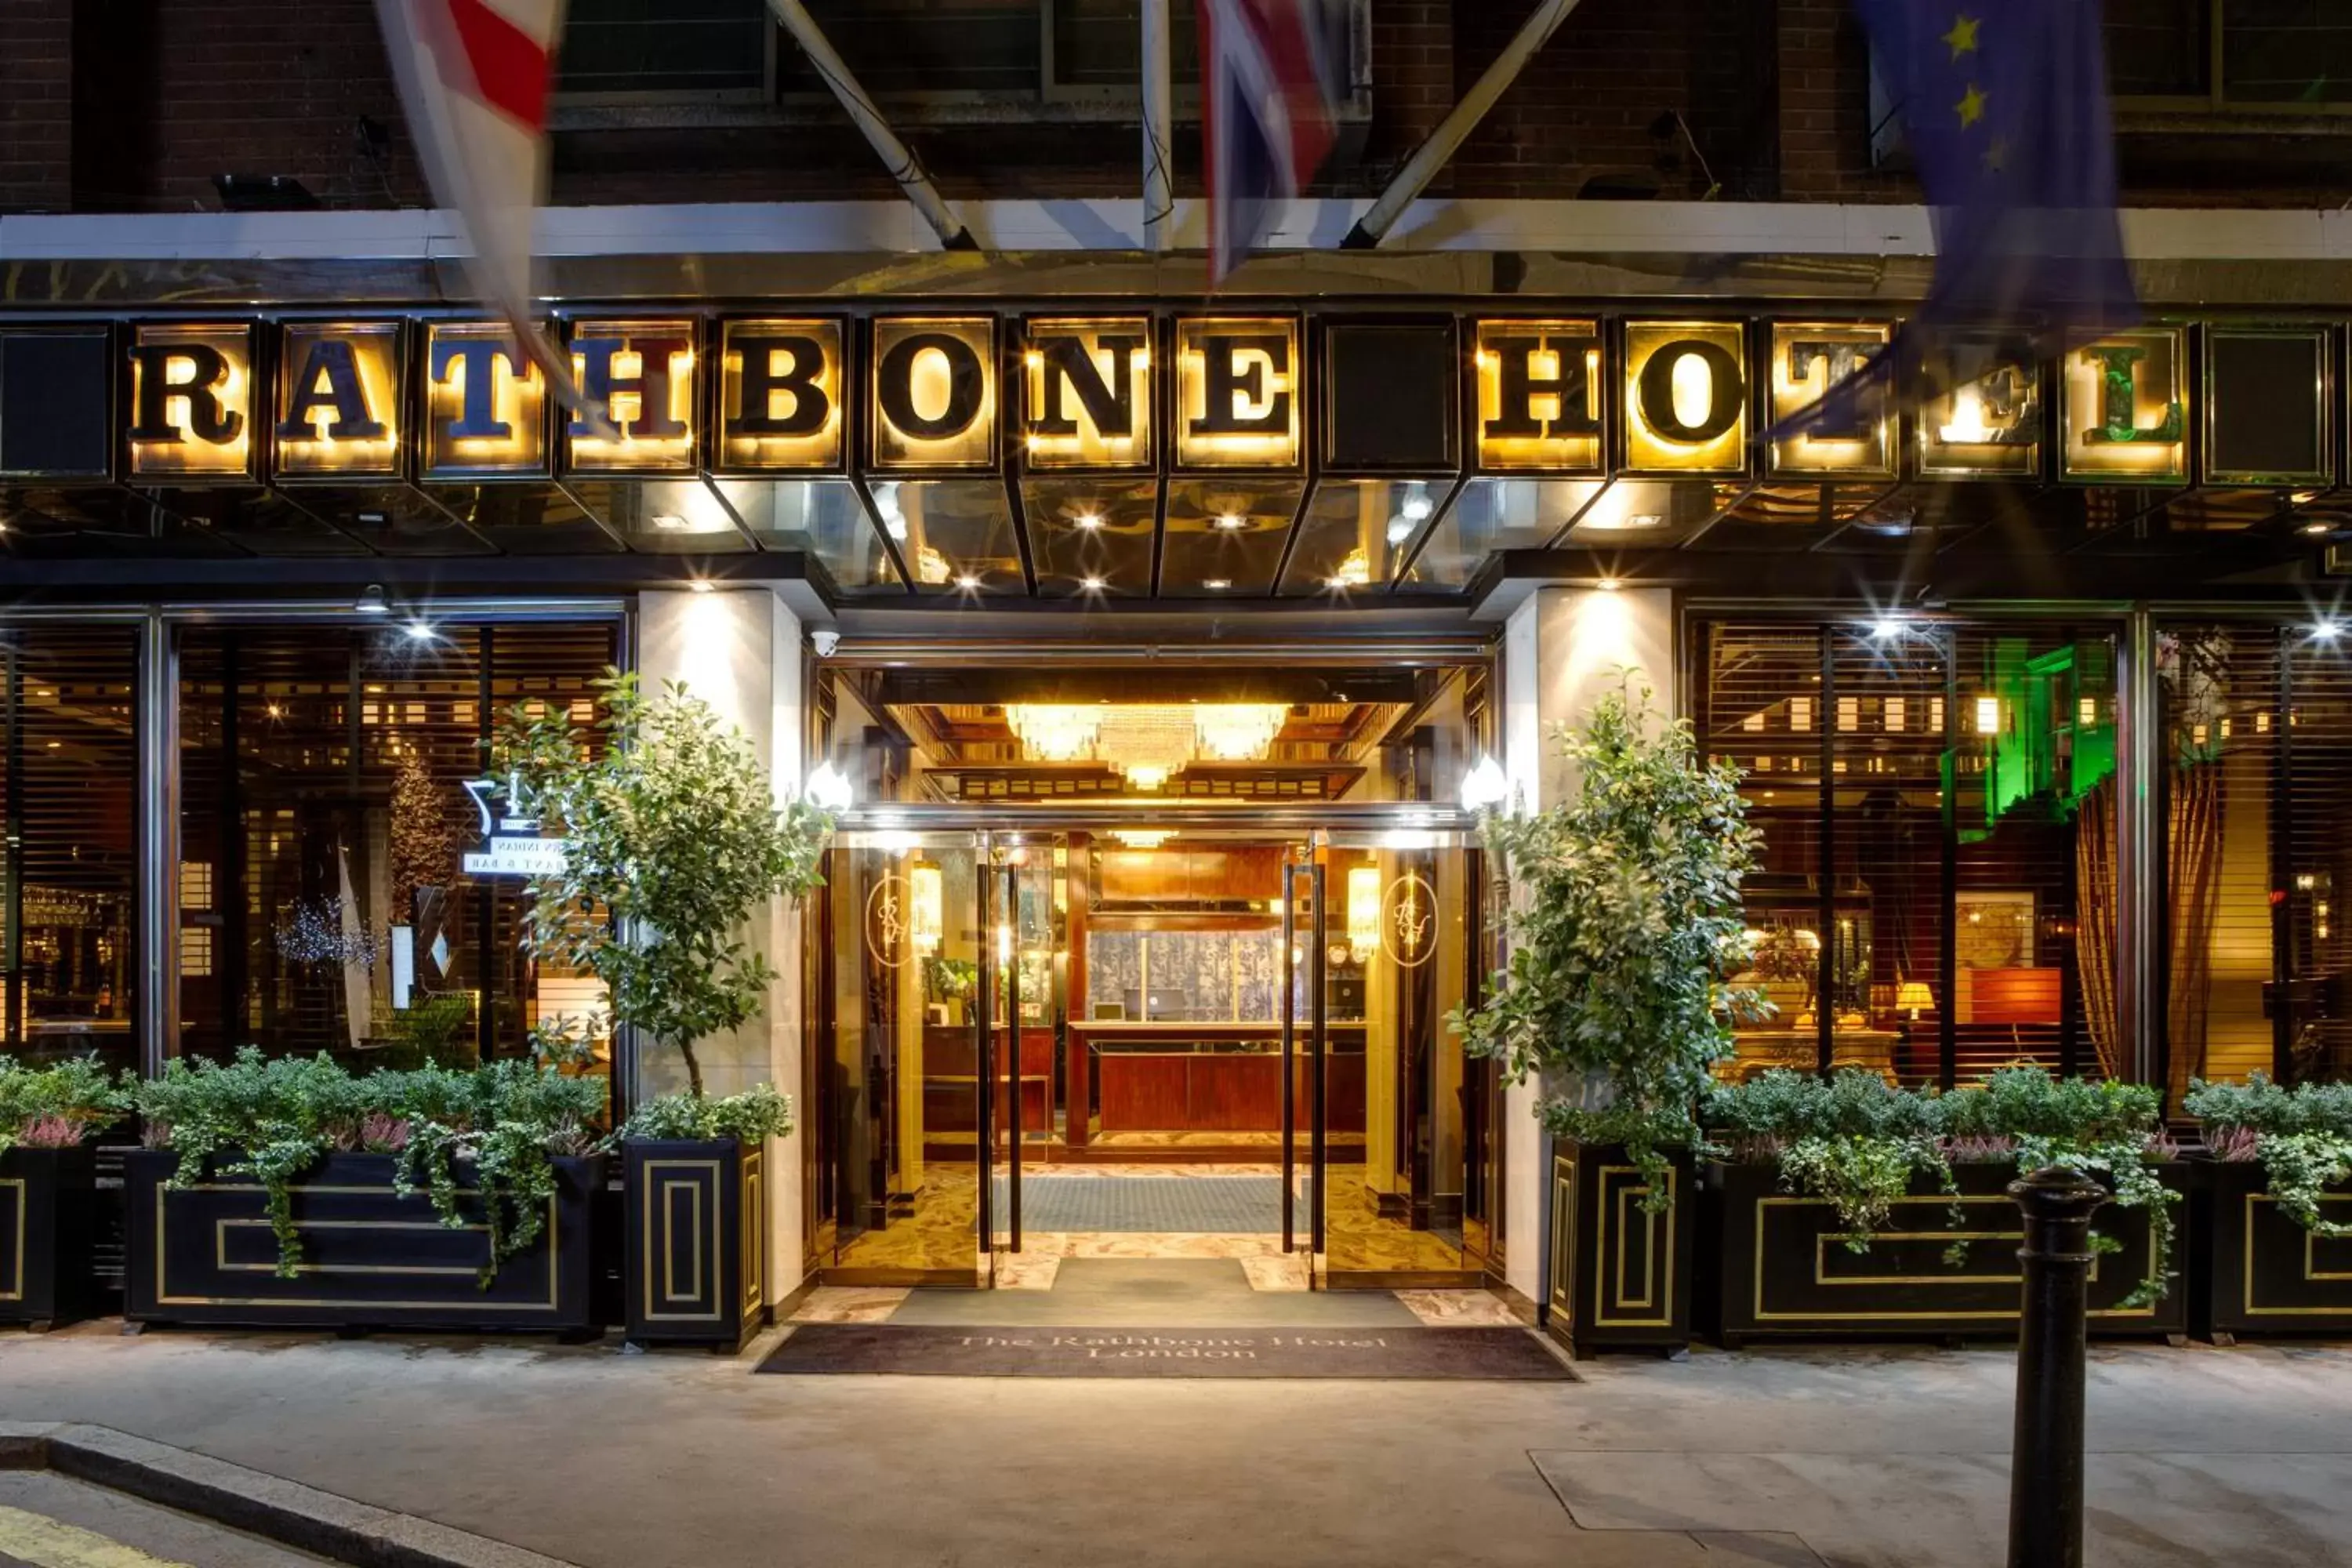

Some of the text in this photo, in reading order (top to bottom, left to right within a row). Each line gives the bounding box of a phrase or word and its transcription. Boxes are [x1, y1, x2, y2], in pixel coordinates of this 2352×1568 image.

[126, 336, 2183, 445] RATHBONE HOTEL
[953, 1336, 1388, 1348] The Rathbone Hotel
[1089, 1347, 1255, 1359] London
